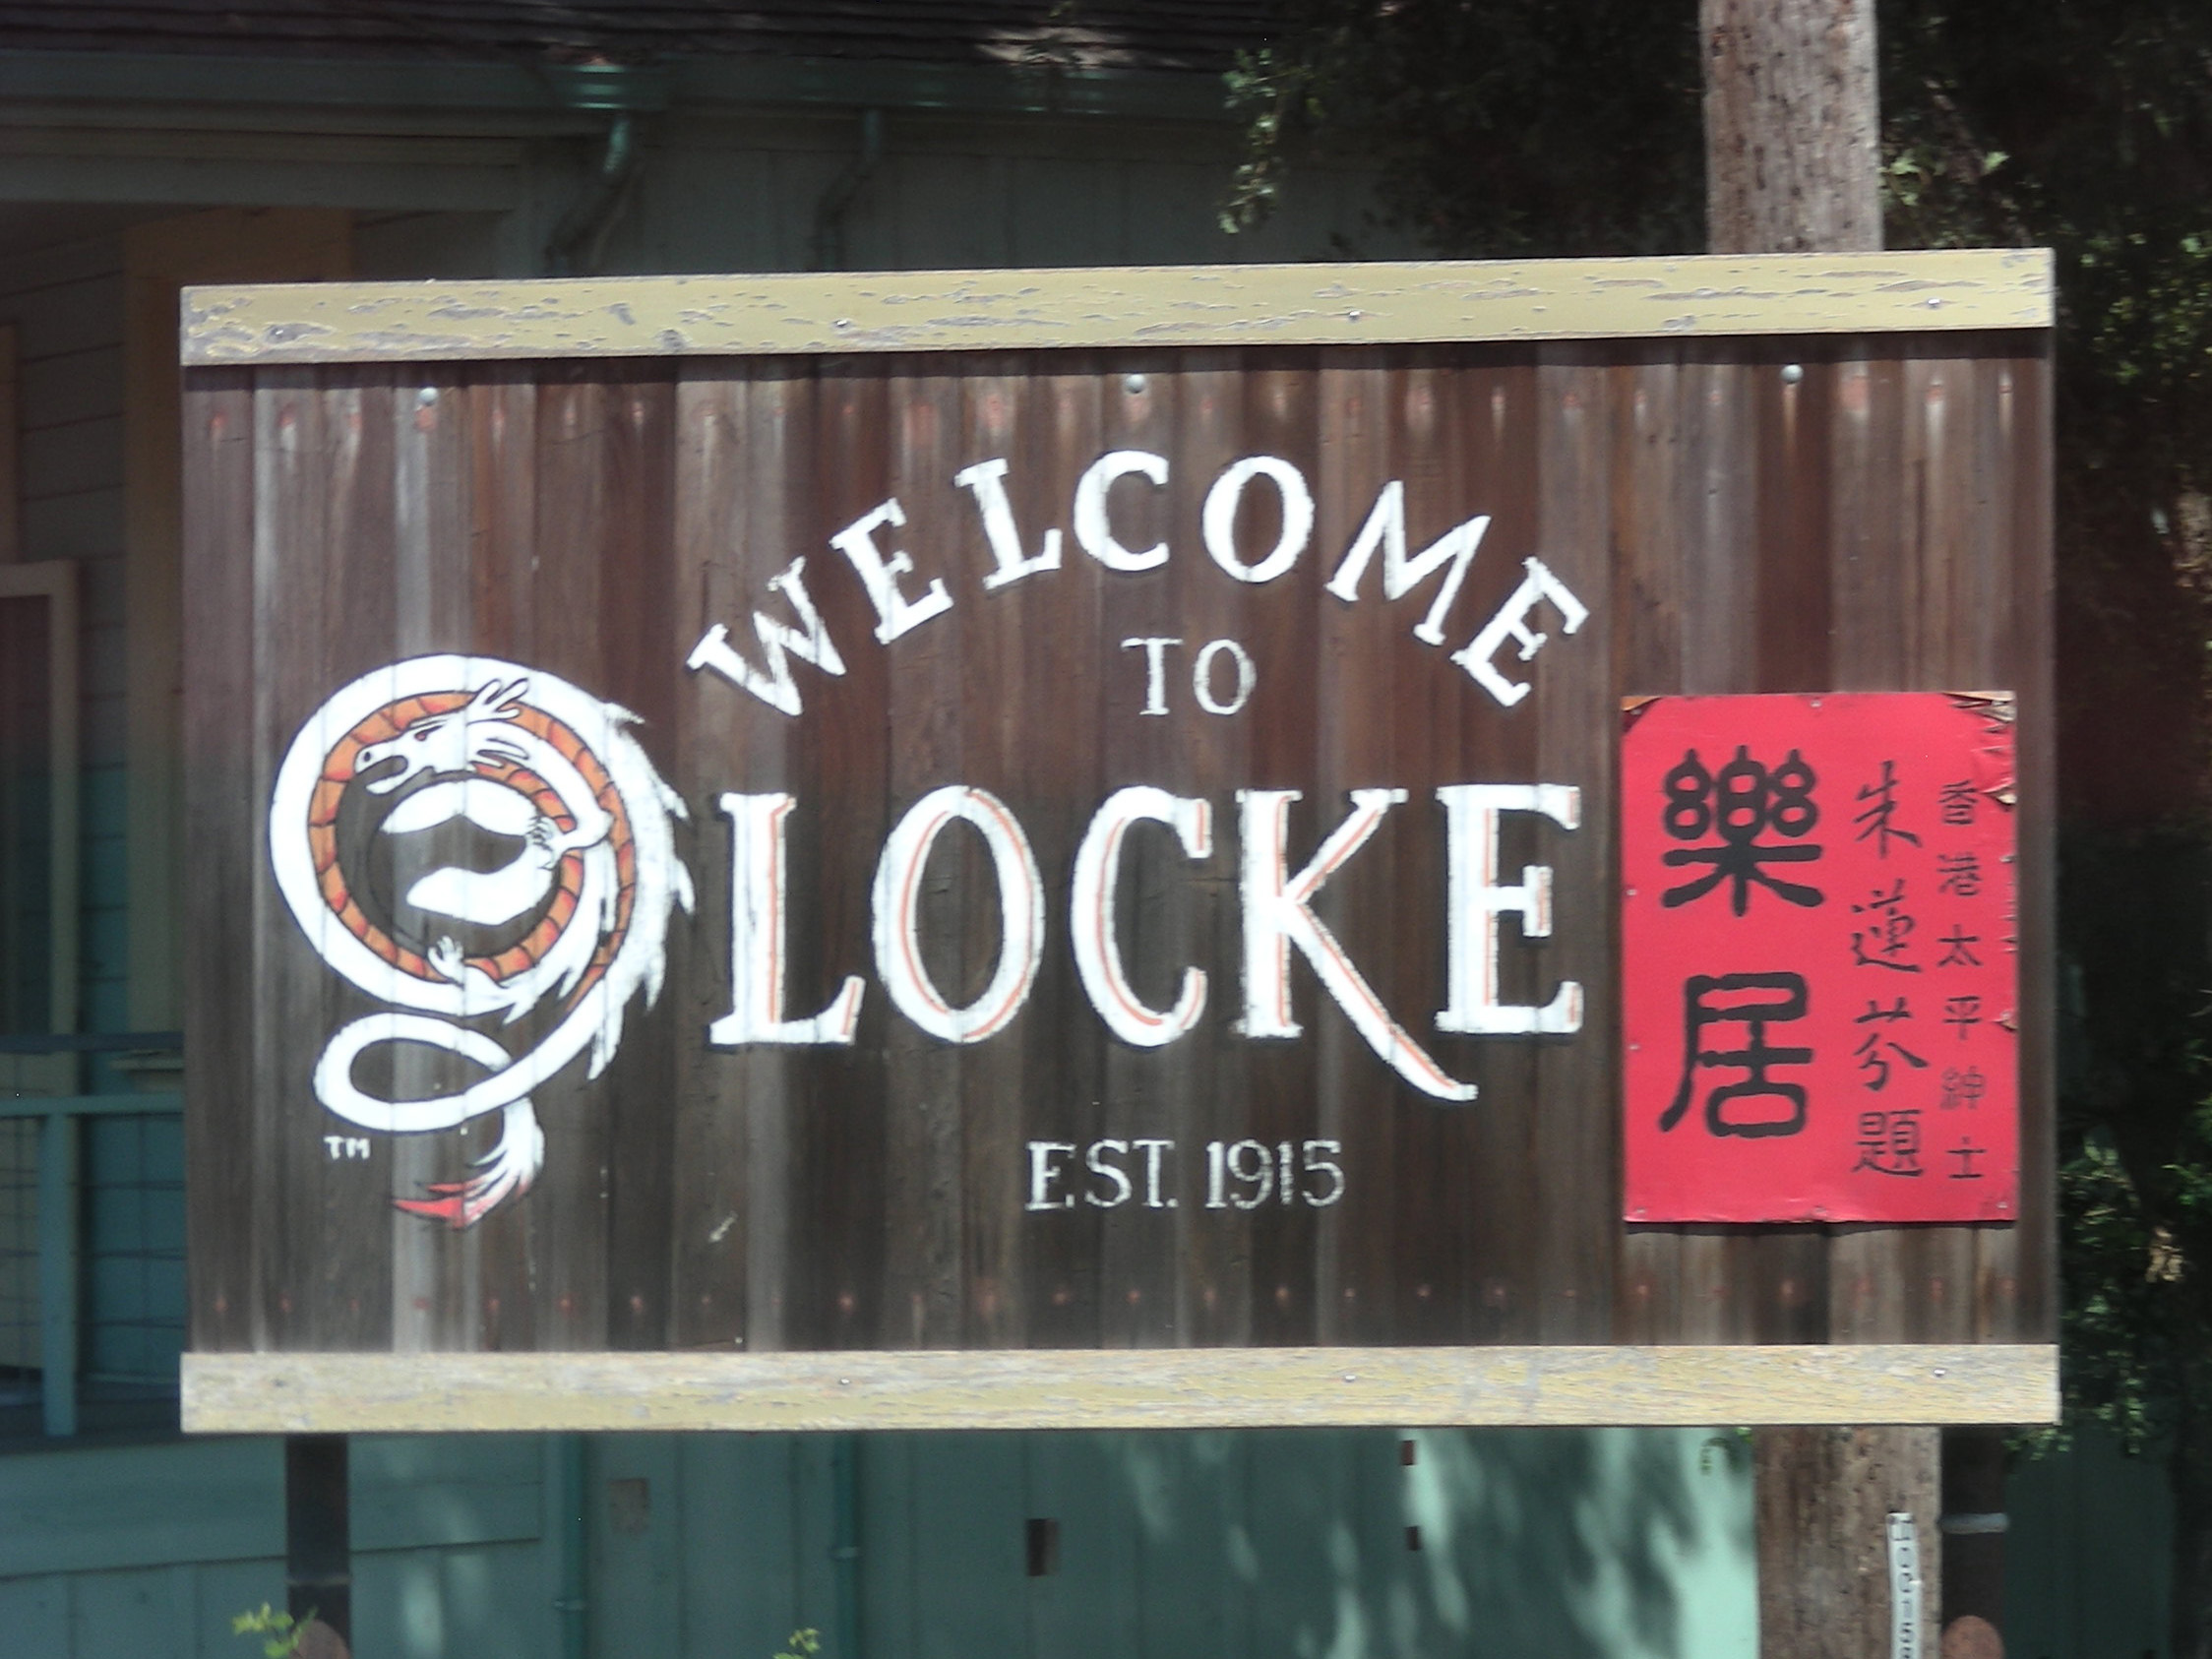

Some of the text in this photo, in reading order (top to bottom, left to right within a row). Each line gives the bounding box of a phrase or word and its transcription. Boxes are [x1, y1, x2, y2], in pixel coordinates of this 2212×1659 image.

[687, 450, 1589, 716] WELCOME
[1121, 638, 1257, 715] TO
[709, 783, 1583, 1101] LOCKE
[1658, 746, 1824, 1138] 樂居
[1936, 778, 1988, 1180] 香港太平紳士
[323, 1136, 371, 1160] TM
[1025, 1138, 1345, 1210] EST. 1915
